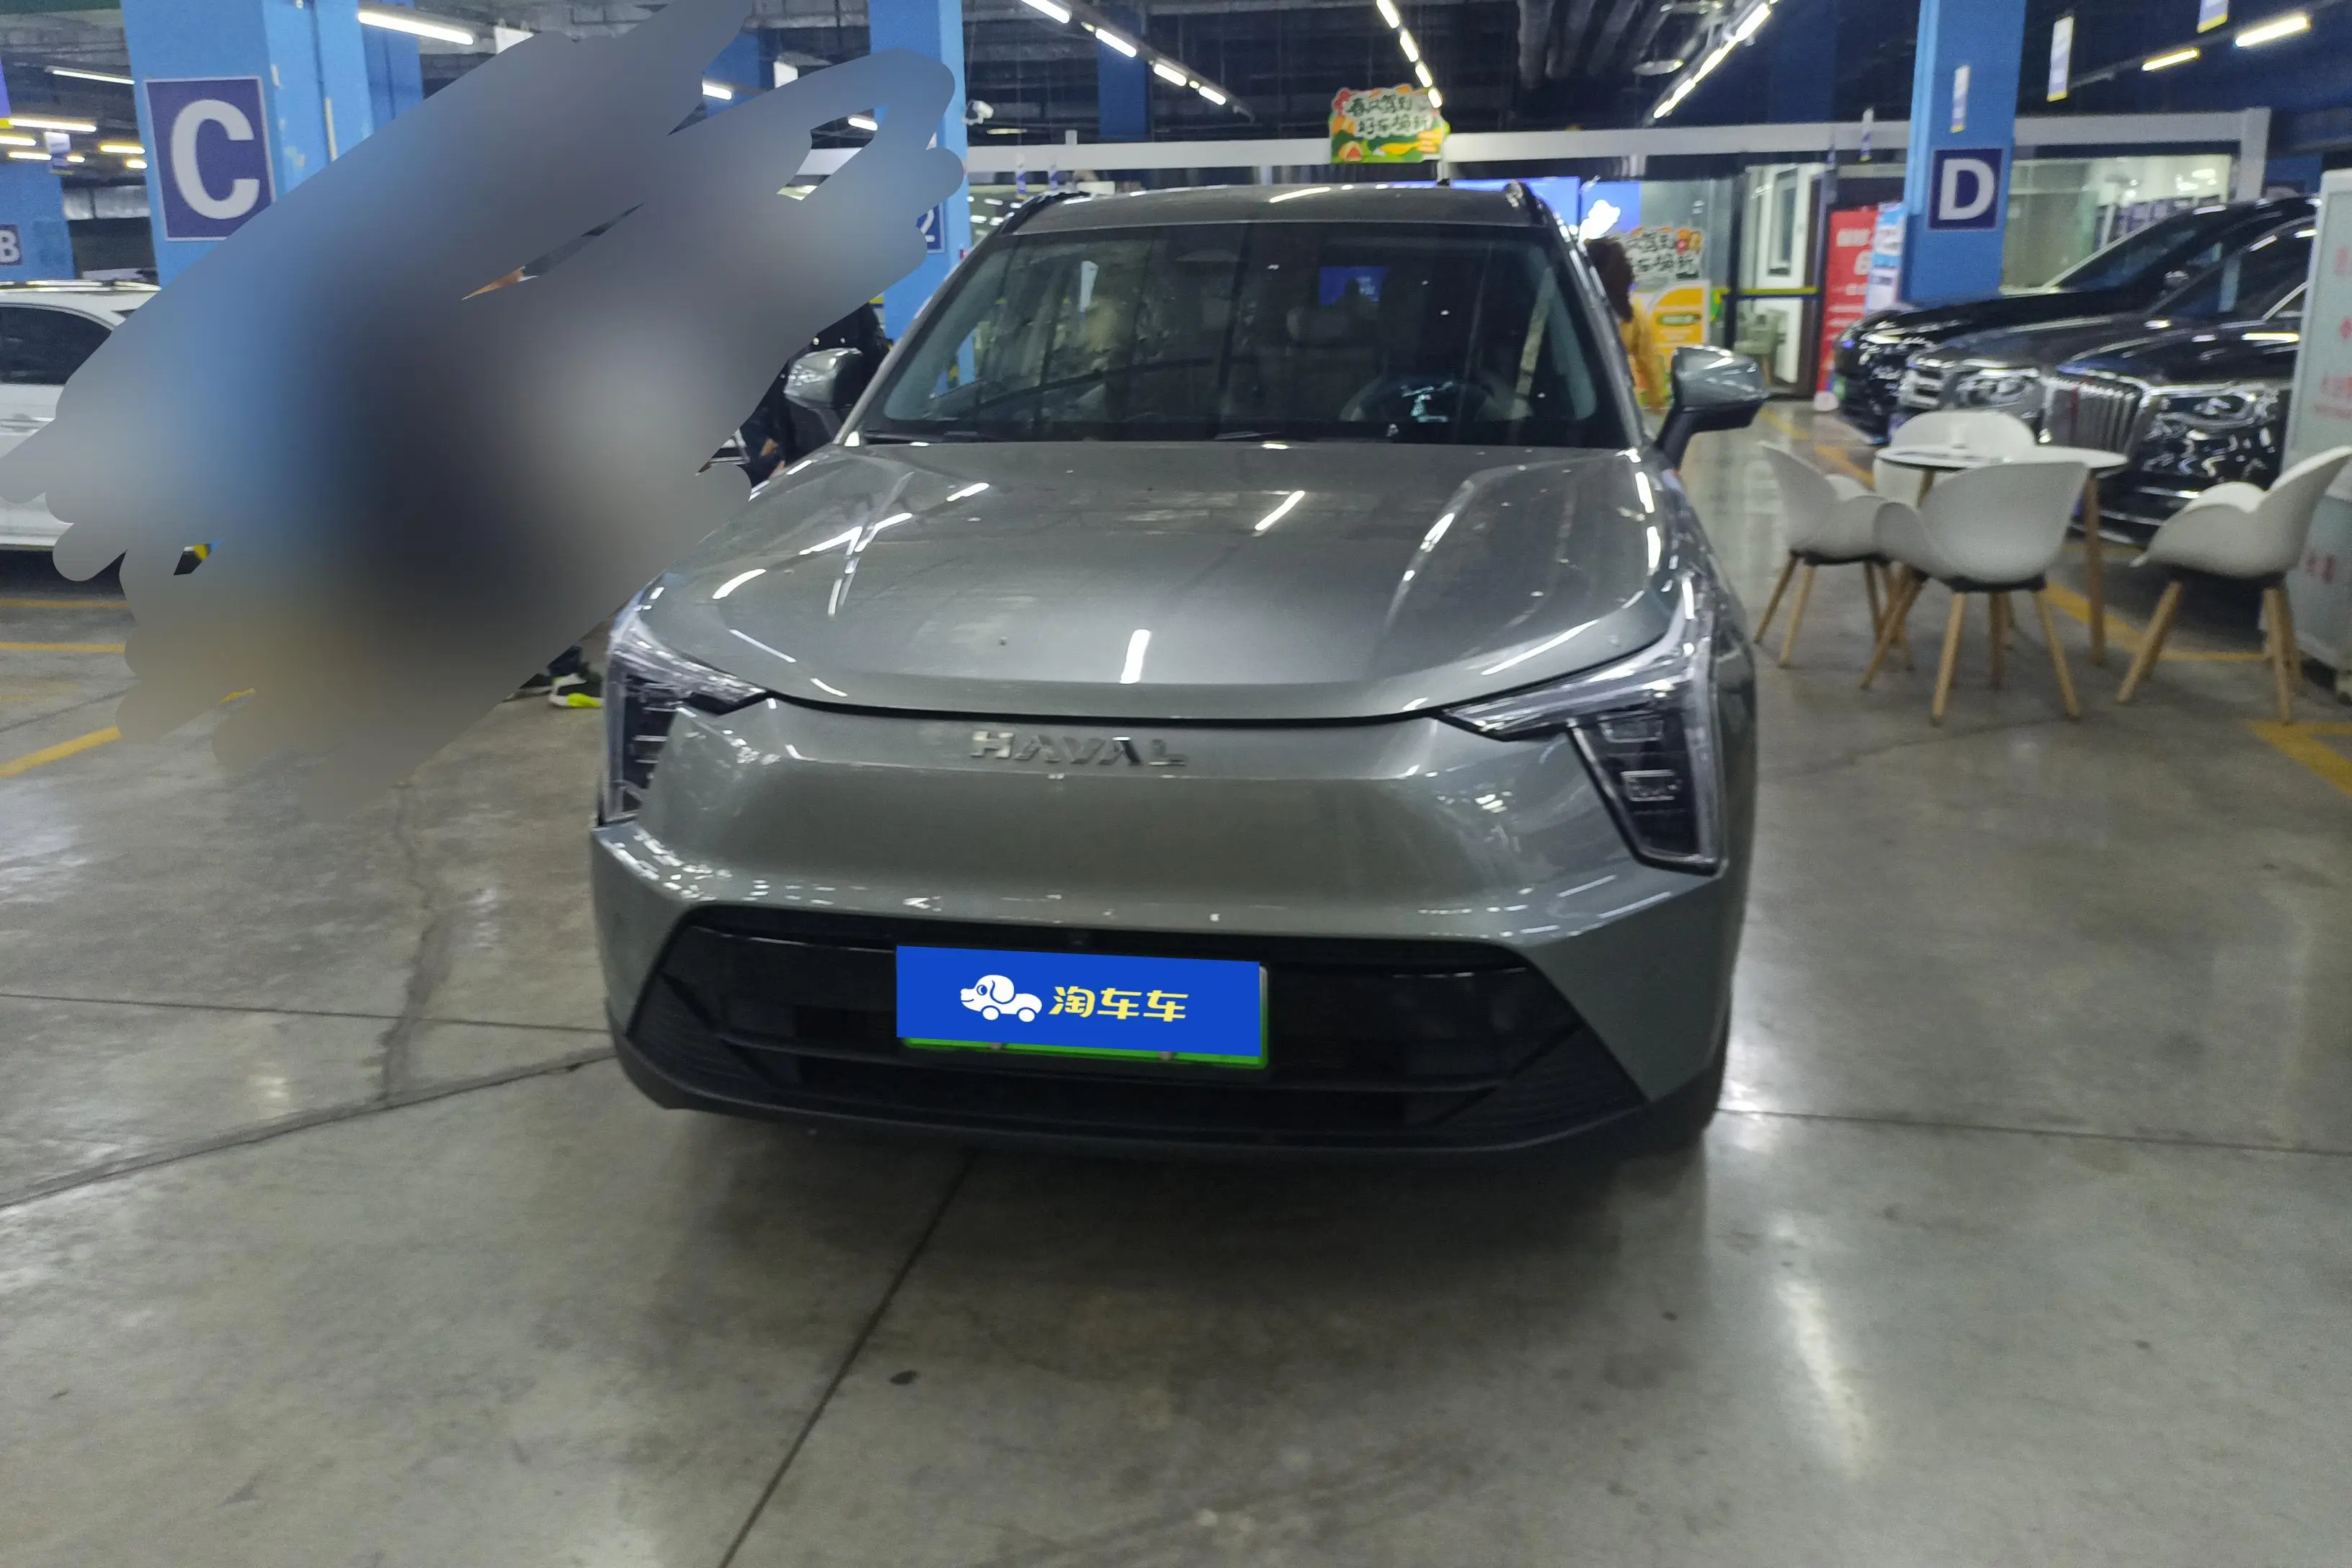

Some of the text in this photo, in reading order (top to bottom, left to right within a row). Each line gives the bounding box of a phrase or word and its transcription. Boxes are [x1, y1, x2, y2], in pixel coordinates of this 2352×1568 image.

[171, 99, 259, 220] C
[1938, 159, 1995, 220] D
[0, 230, 20, 262] B
[971, 730, 1186, 766] HAVAL
